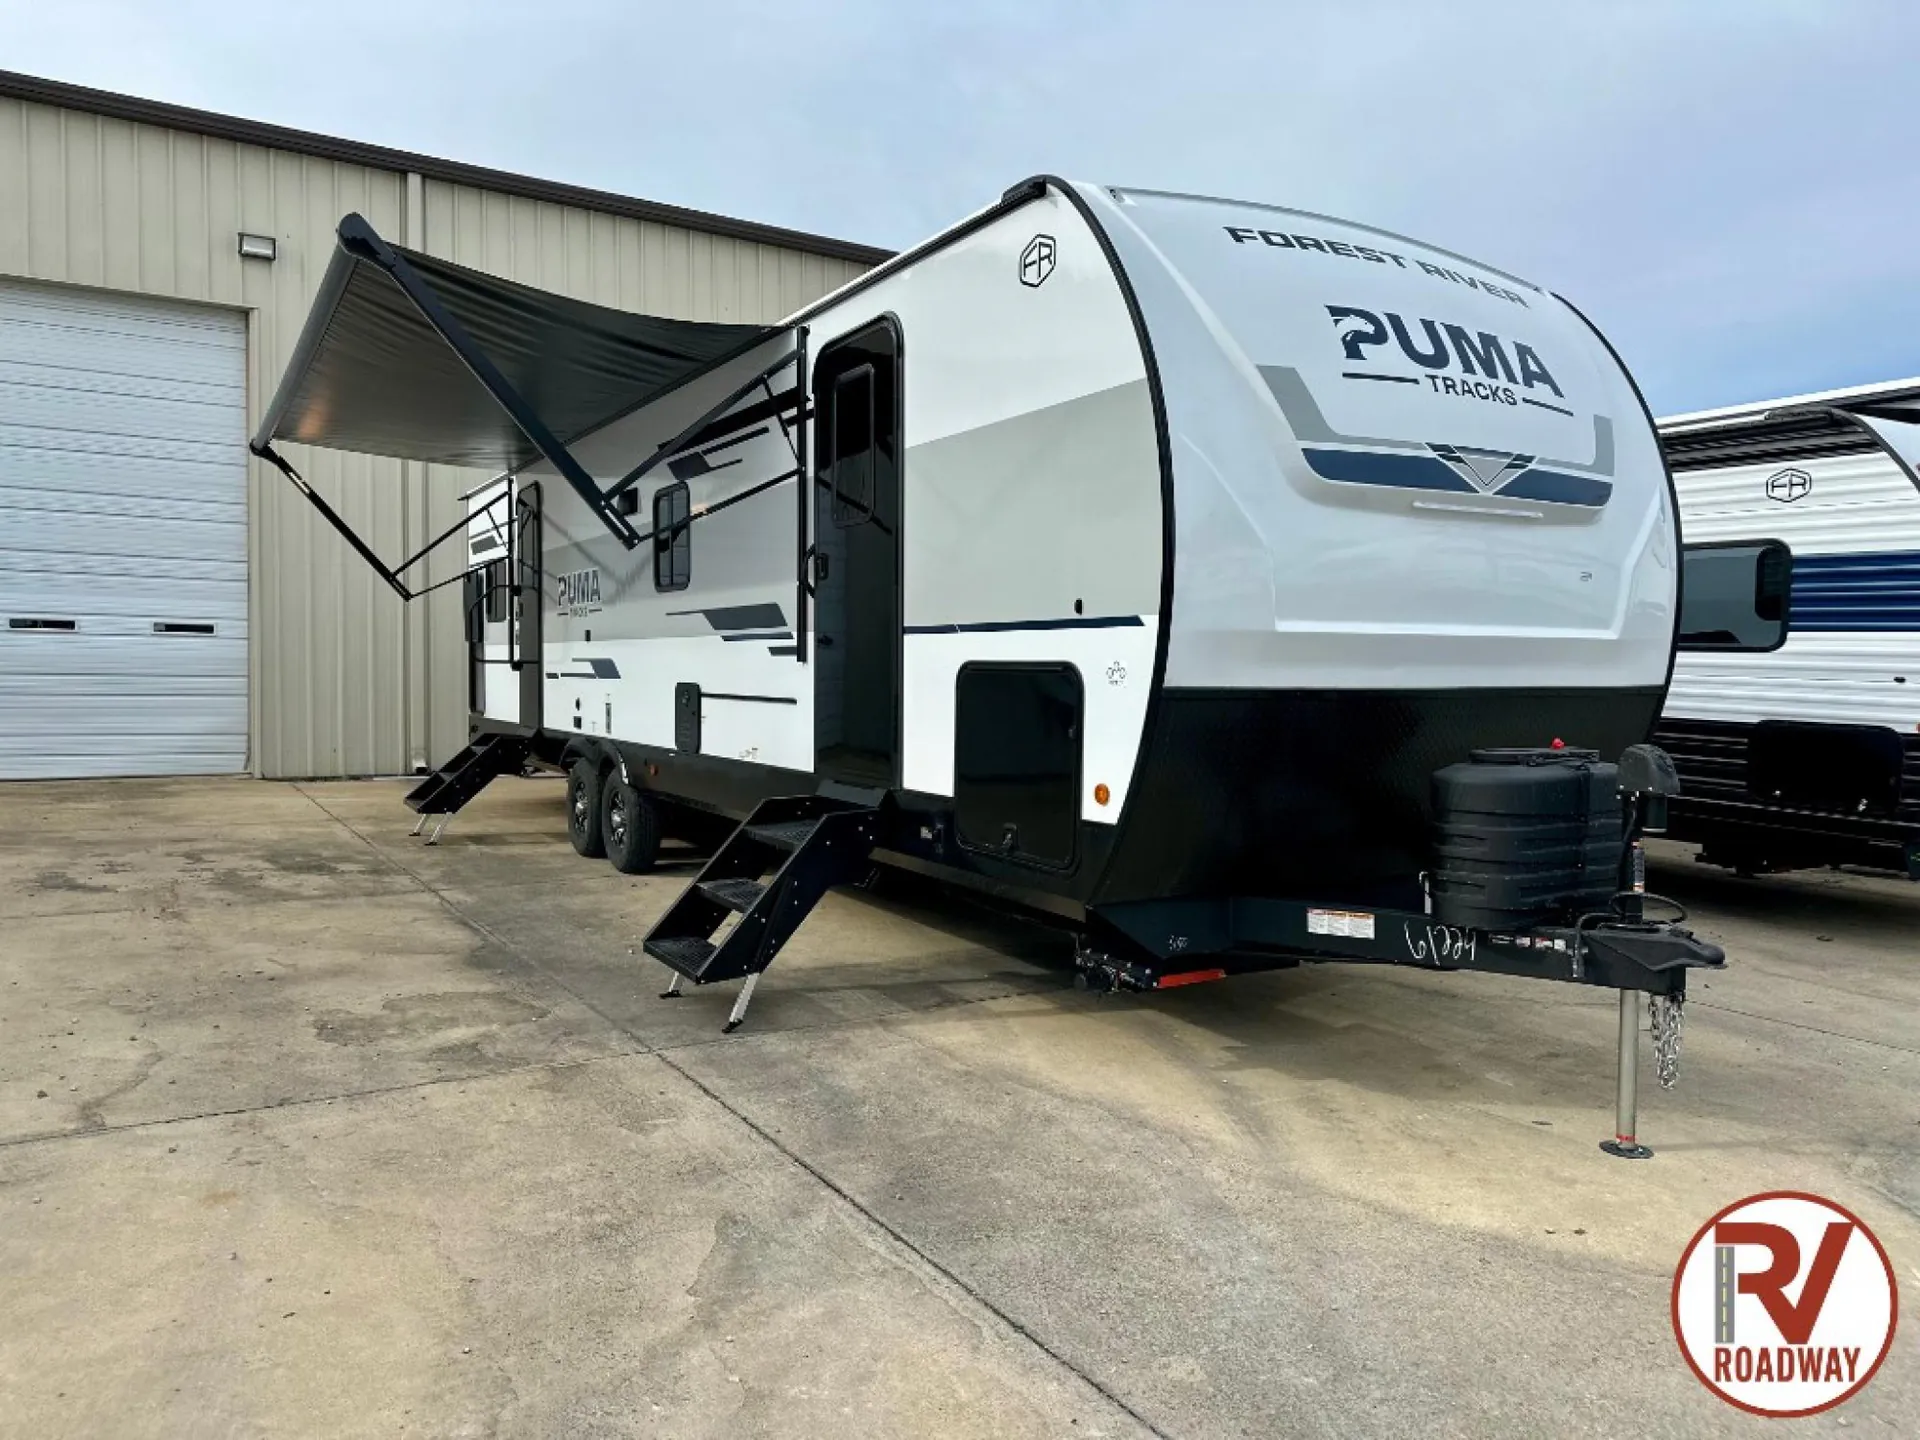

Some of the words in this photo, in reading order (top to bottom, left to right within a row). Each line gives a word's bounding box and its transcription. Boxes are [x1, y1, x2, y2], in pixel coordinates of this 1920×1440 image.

[1222, 226, 1408, 269] FOREST
[1413, 258, 1530, 309] RIVER
[1325, 304, 1565, 398] PUMA
[1425, 374, 1518, 406] TRACKS
[558, 570, 601, 607] PUMA
